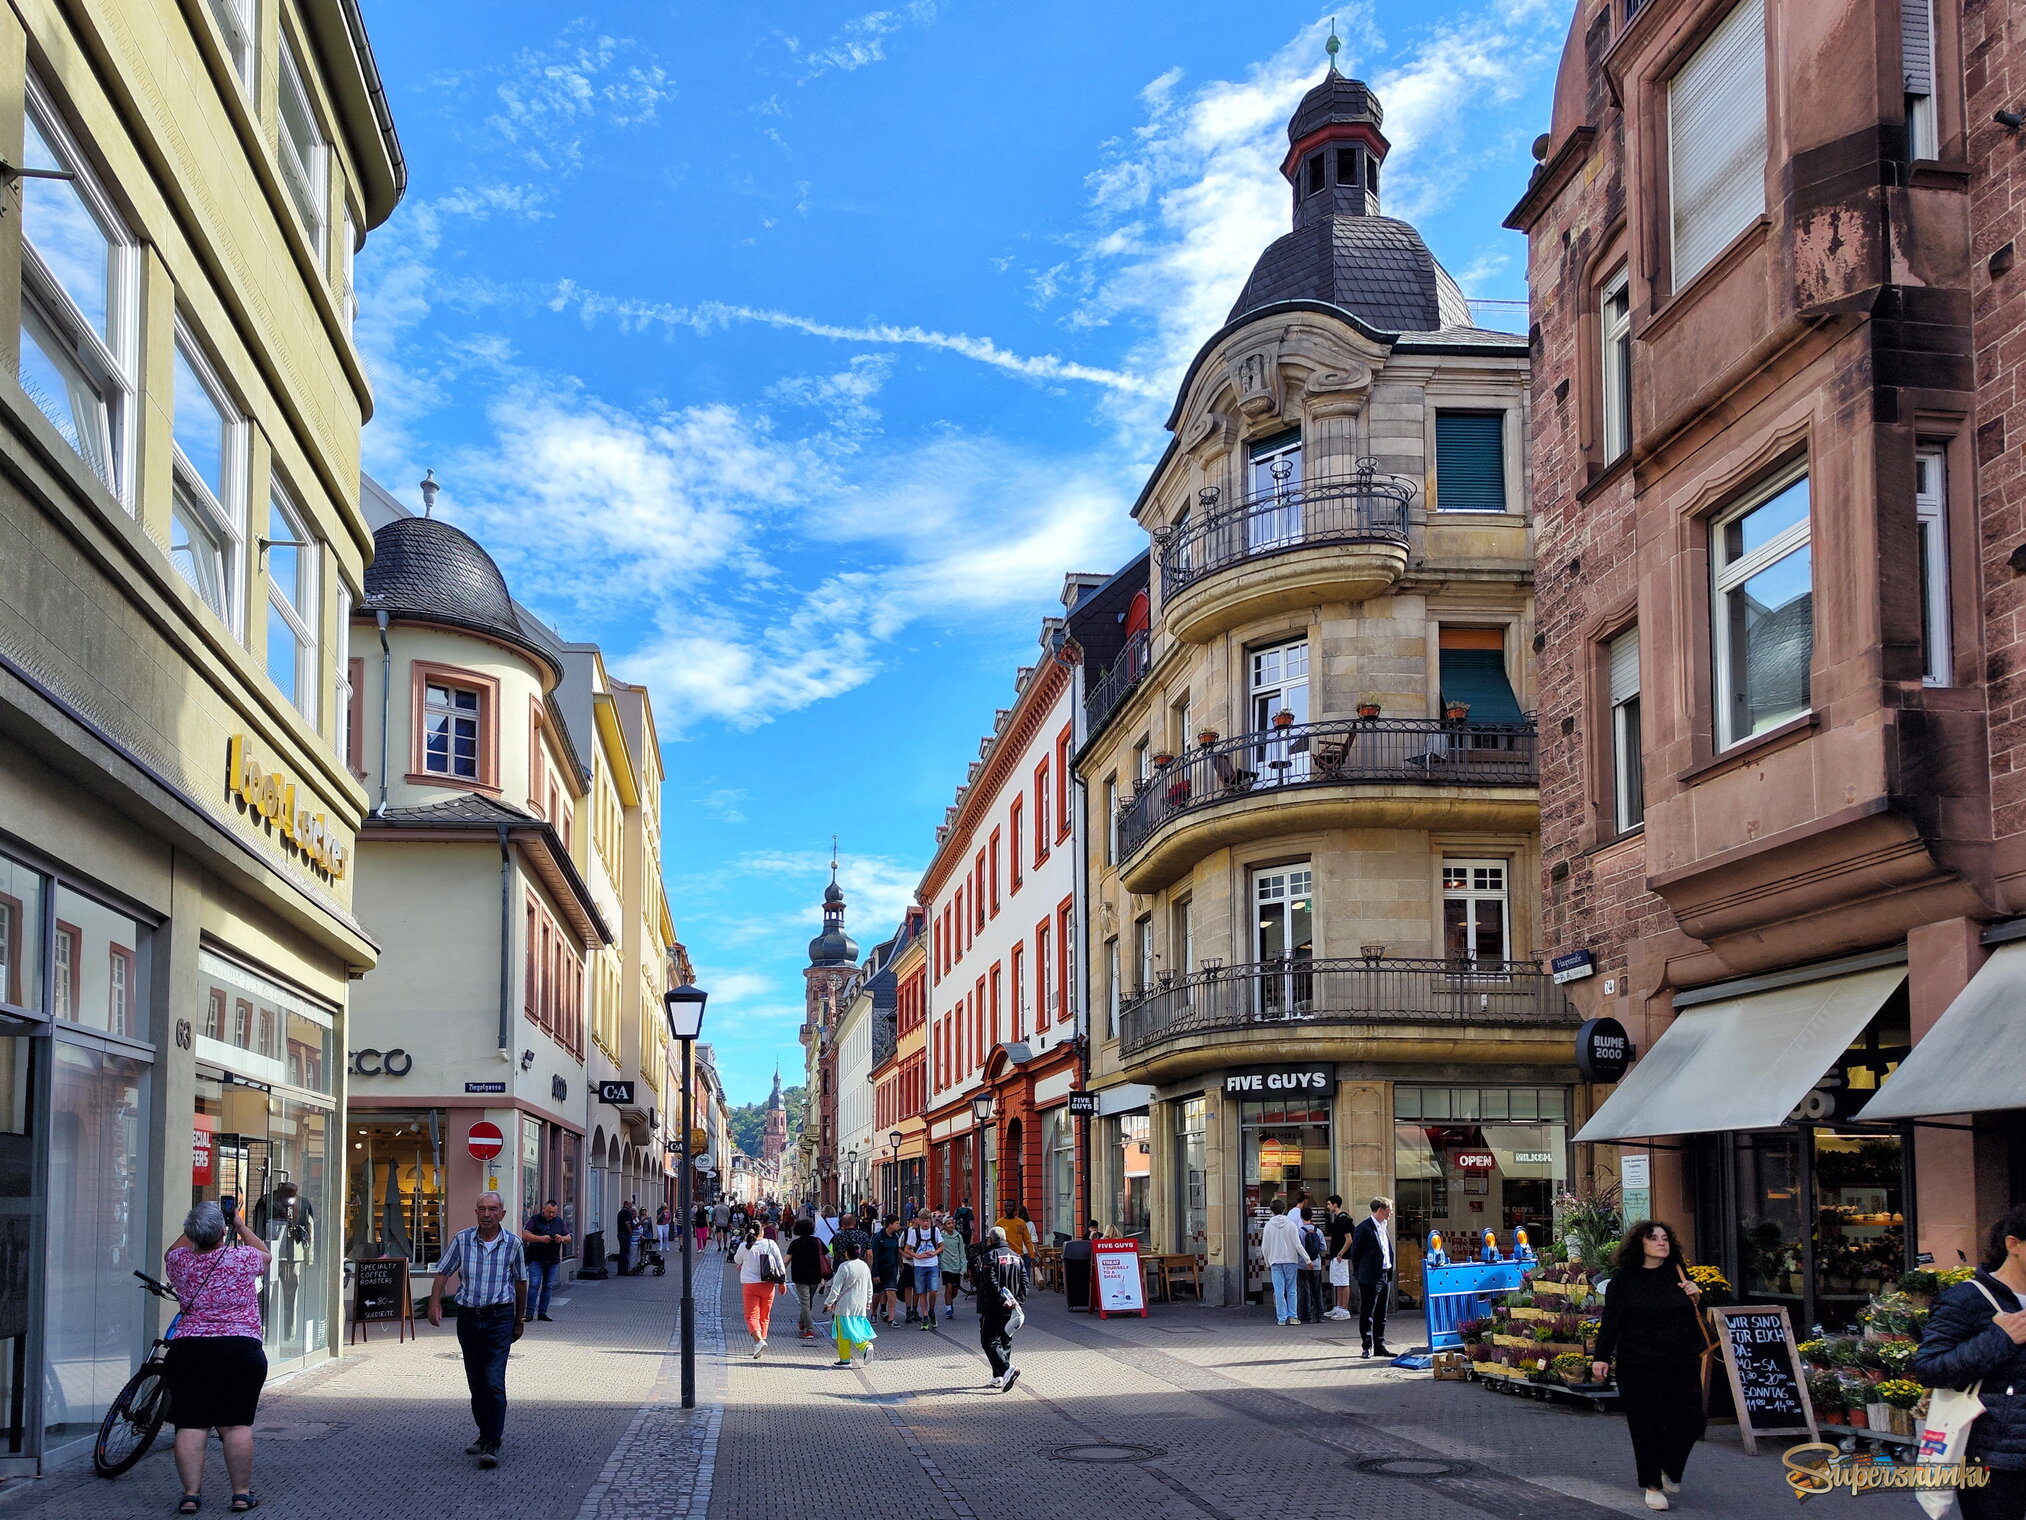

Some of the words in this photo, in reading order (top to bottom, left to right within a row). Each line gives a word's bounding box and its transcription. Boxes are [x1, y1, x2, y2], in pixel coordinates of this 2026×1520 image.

[1605, 980, 1614, 993] 74
[176, 1018, 192, 1050] 63
[1593, 1035, 1625, 1049] BLUME
[1596, 1048, 1623, 1060] 2000
[1227, 1075, 1263, 1092] FIVE
[1267, 1072, 1327, 1089] GUYS
[603, 1085, 629, 1100] C&A
[1071, 1103, 1093, 1111] GUYS
[1073, 1097, 1091, 1105] FIVE
[1459, 1155, 1492, 1167] OPEN
[360, 1263, 397, 1272] SPECIALTY
[360, 1270, 388, 1279] COFFEE
[360, 1277, 393, 1286] ROASTERS
[1725, 1316, 1749, 1328] WIR
[1751, 1315, 1780, 1328] SIND
[1729, 1329, 1752, 1343] FÜR
[1755, 1328, 1786, 1343] EUCH
[1742, 1385, 1789, 1399] SONNTAG
